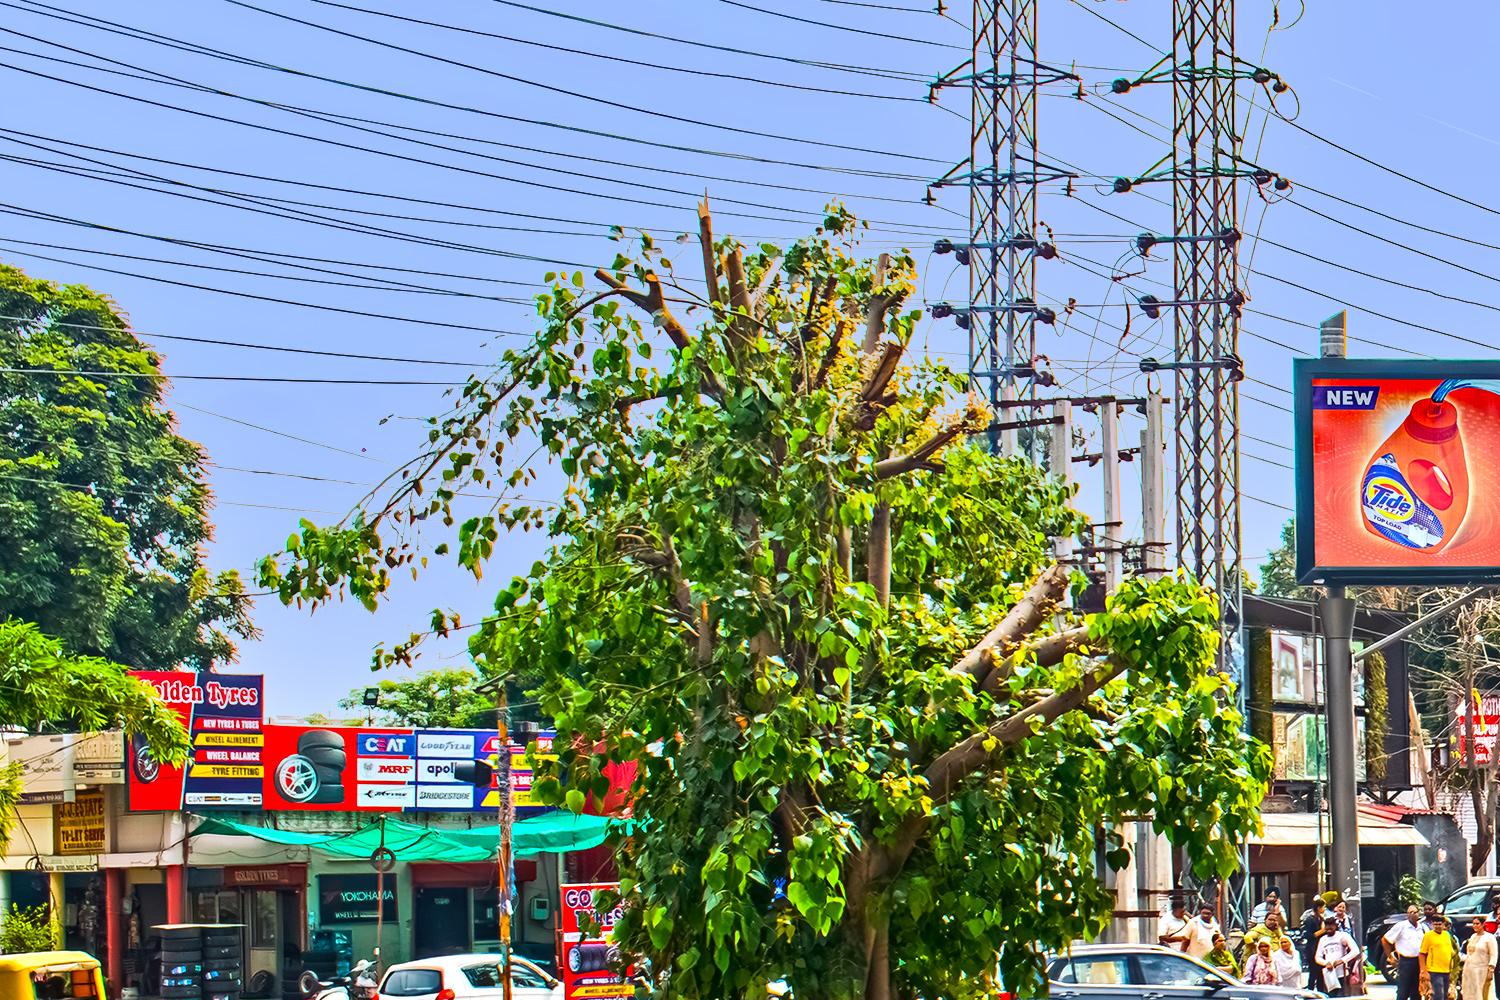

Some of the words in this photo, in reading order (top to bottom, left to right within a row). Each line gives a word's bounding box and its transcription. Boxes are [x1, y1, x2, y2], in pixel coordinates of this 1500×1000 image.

[1327, 390, 1374, 406] NEW
[1370, 485, 1411, 512] Tide
[1373, 515, 1386, 523] TOP
[1385, 520, 1402, 530] LOAD
[206, 681, 258, 709] Tyres
[365, 737, 406, 753] CEAT
[206, 751, 229, 761] WHEEL
[230, 752, 259, 761] BALANCE
[211, 766, 229, 776] TYRE
[232, 767, 259, 776] FITTING
[377, 765, 413, 774] MRF
[419, 791, 471, 800] BRIDGESTONE
